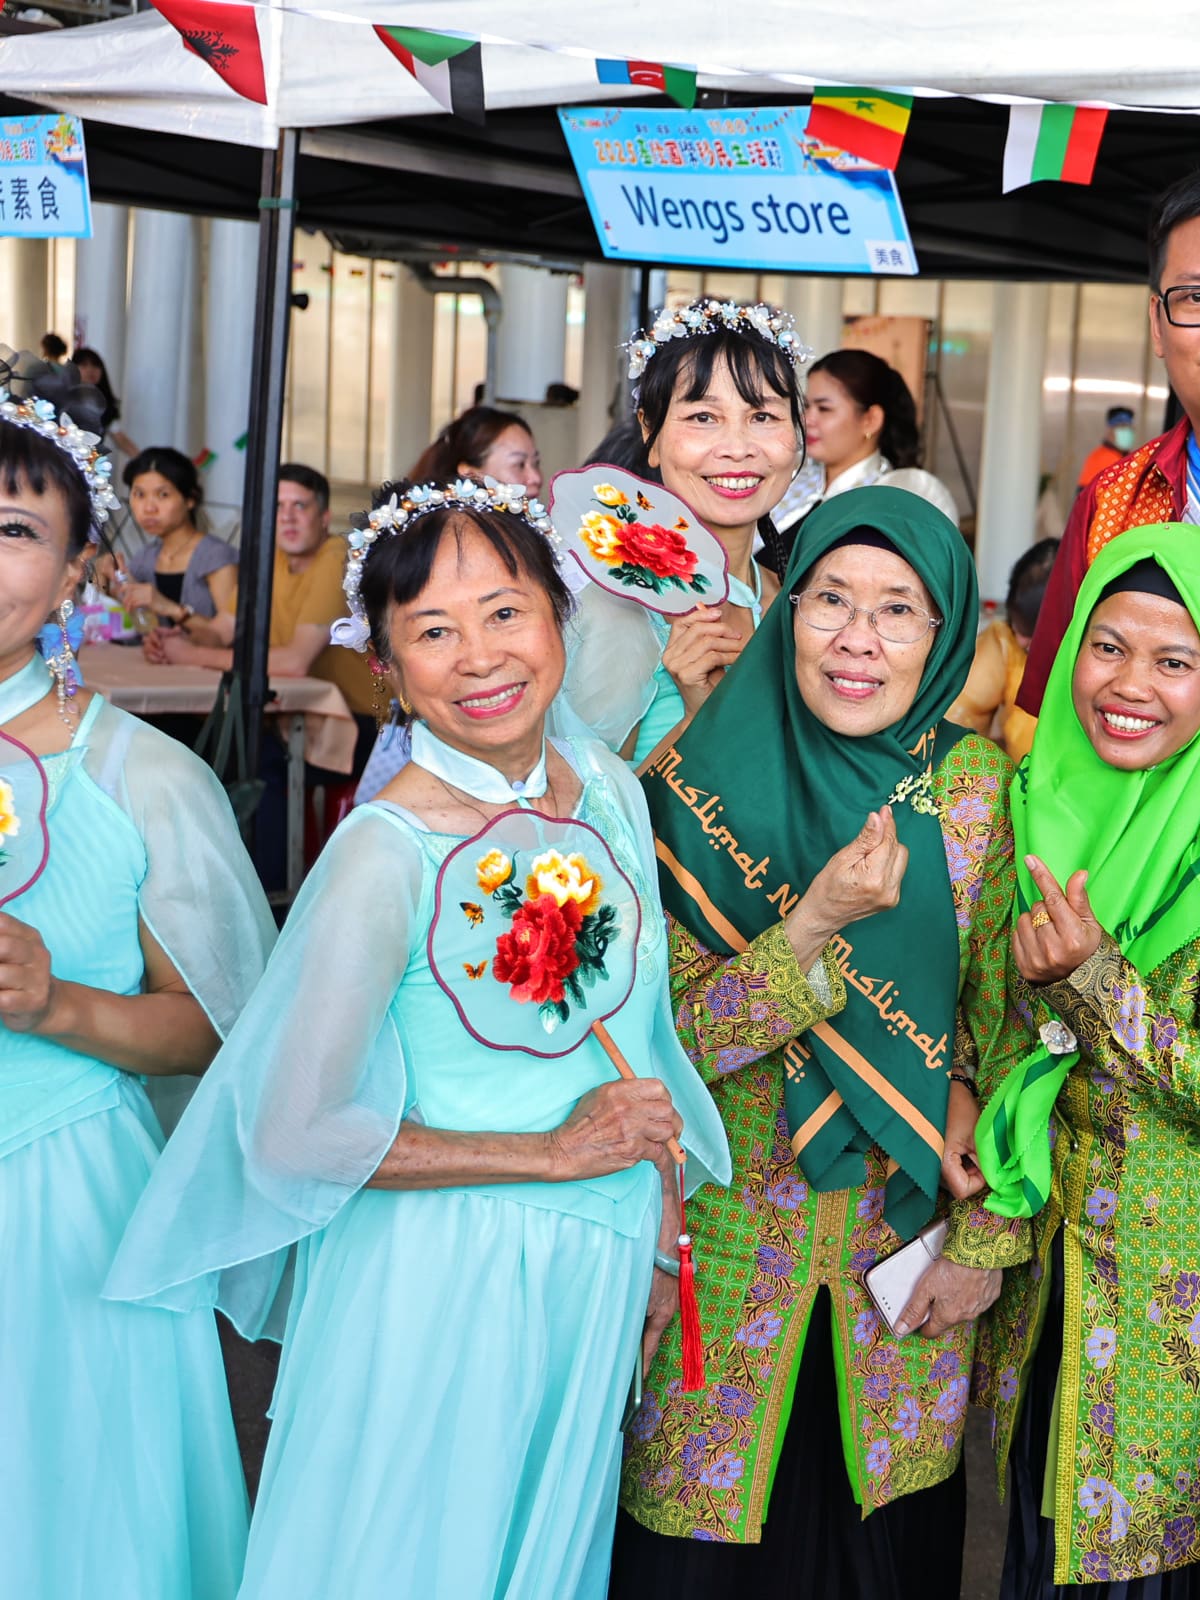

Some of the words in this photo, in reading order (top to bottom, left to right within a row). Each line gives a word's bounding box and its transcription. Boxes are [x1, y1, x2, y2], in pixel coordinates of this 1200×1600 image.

[0, 176, 60, 220] 素食
[620, 184, 745, 244] Wengs
[751, 193, 851, 235] store
[648, 743, 770, 889] Muslimat
